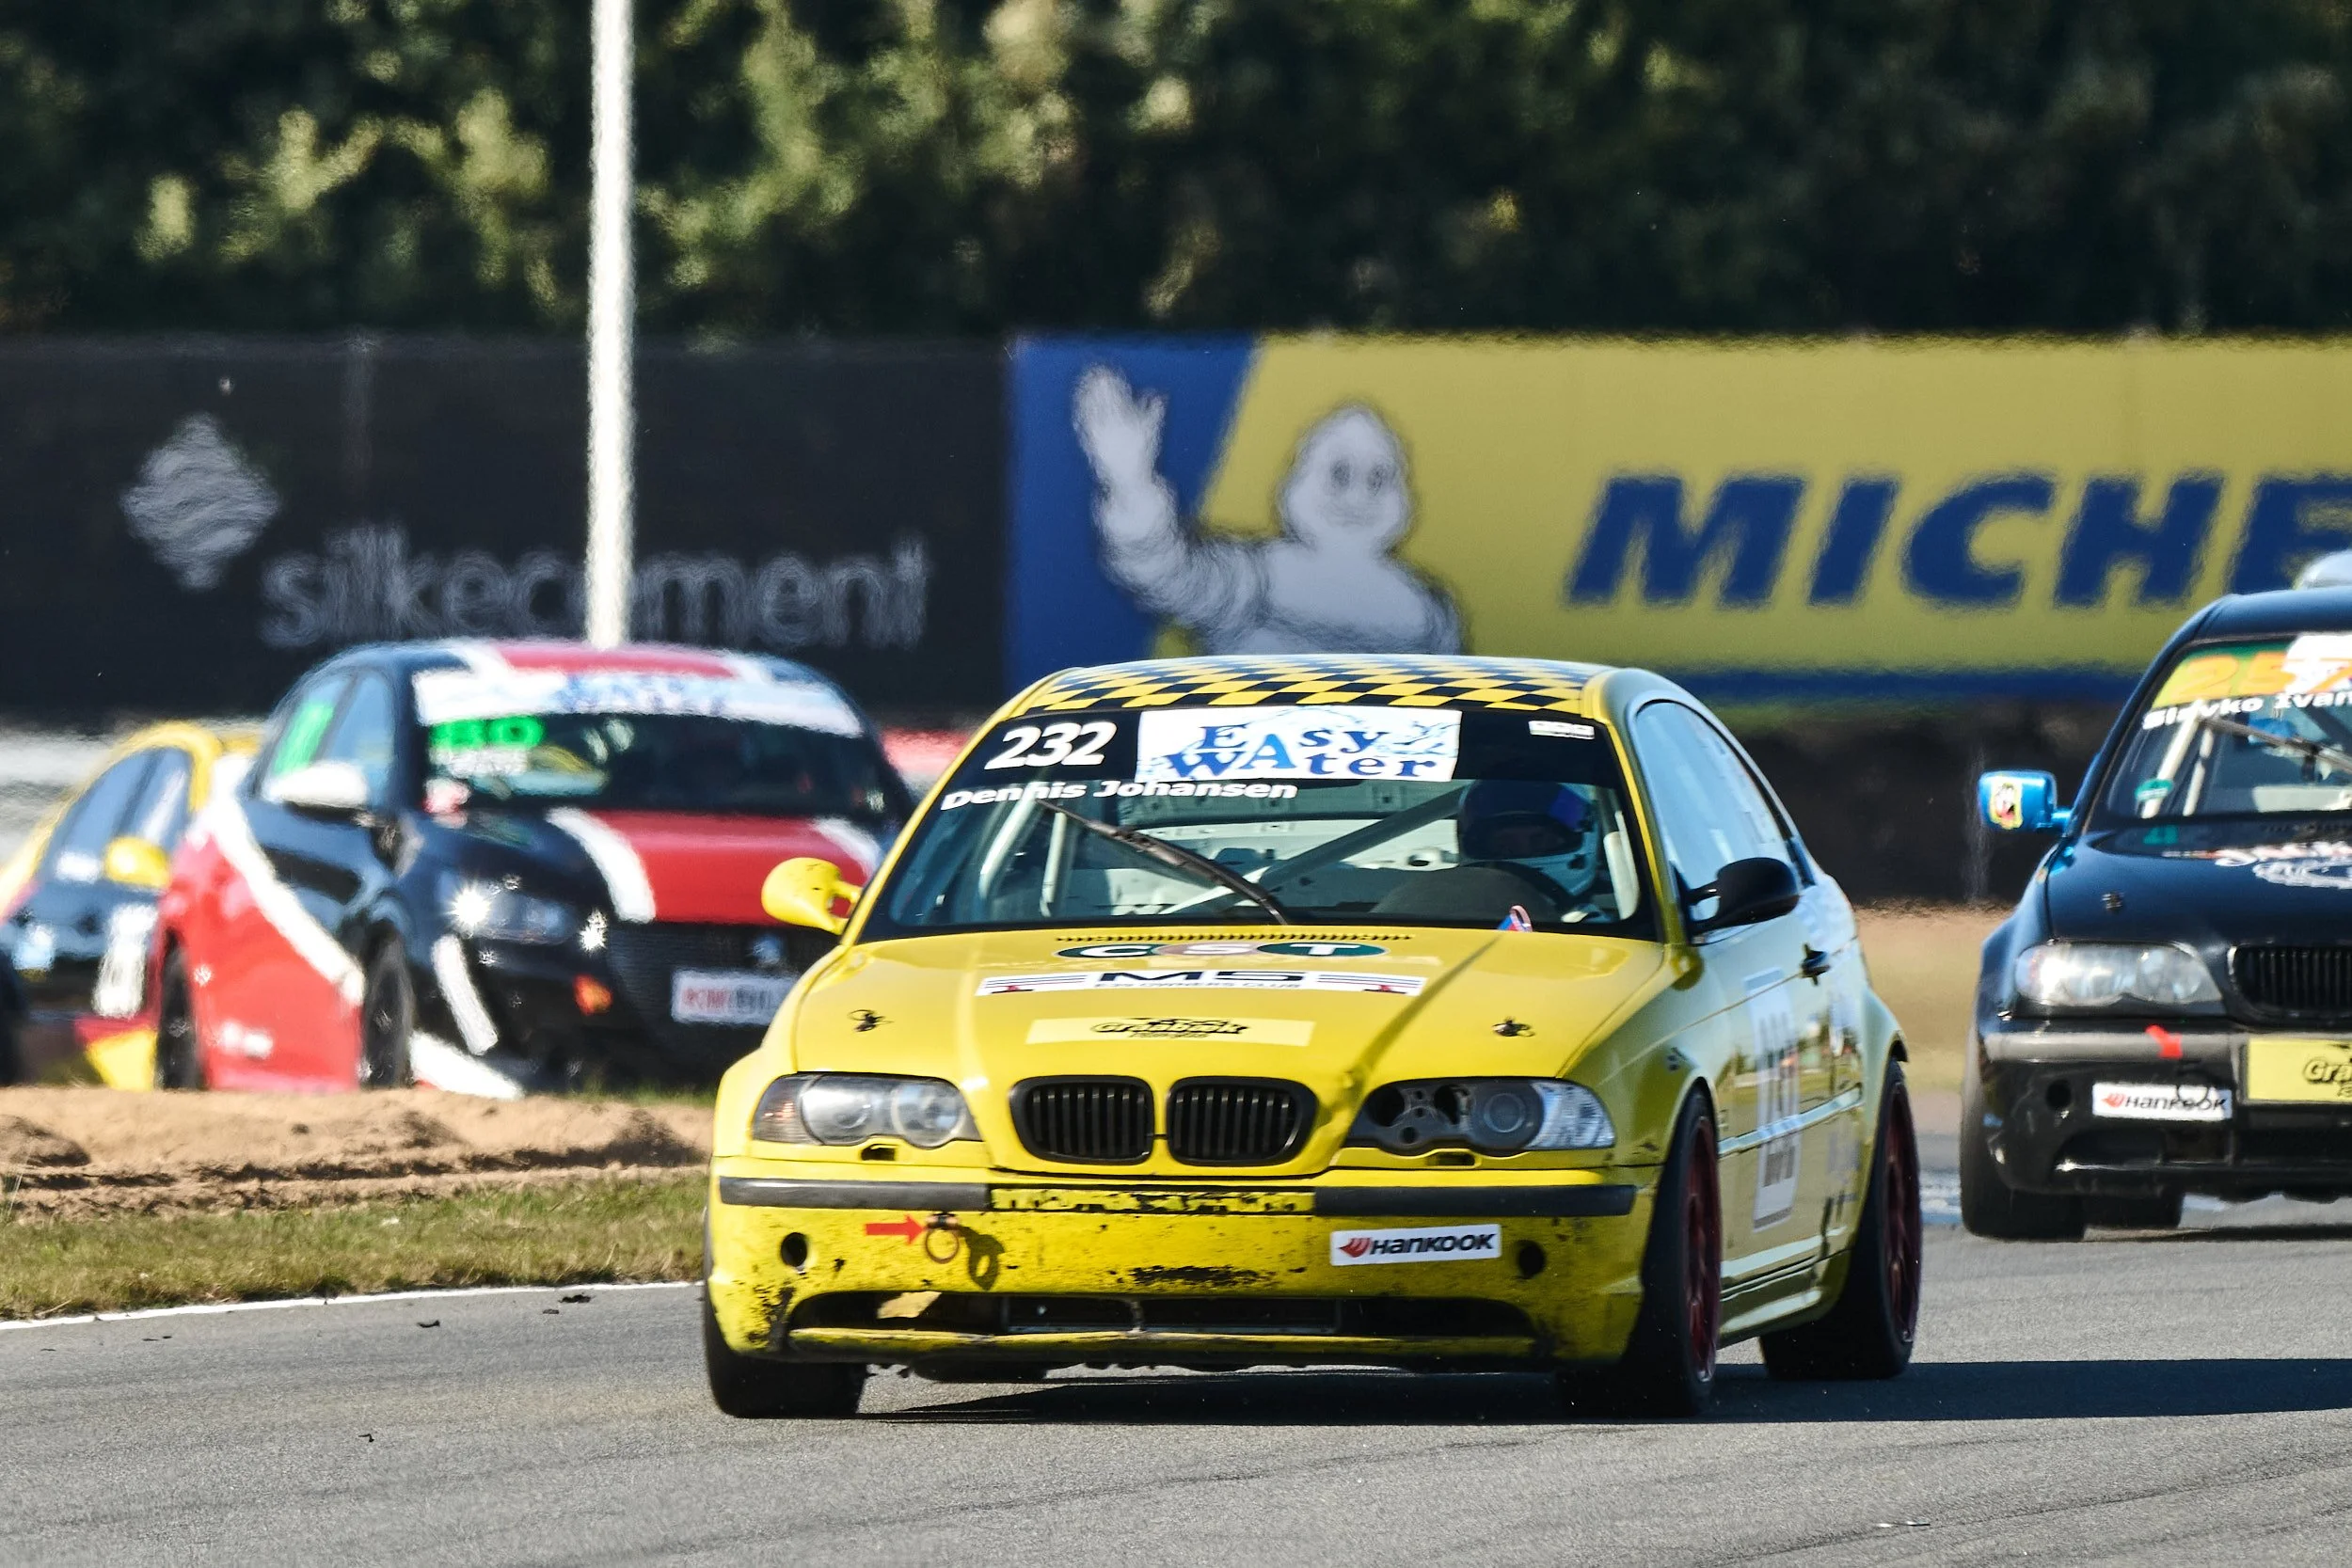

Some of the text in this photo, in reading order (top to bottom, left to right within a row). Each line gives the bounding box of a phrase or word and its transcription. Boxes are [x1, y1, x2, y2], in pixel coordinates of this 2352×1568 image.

[263, 527, 928, 647] silkecment
[984, 721, 1118, 769] 232
[941, 780, 1298, 811] Dennis Johansen
[1079, 943, 1360, 958] CST
[1099, 970, 1307, 982] M5
